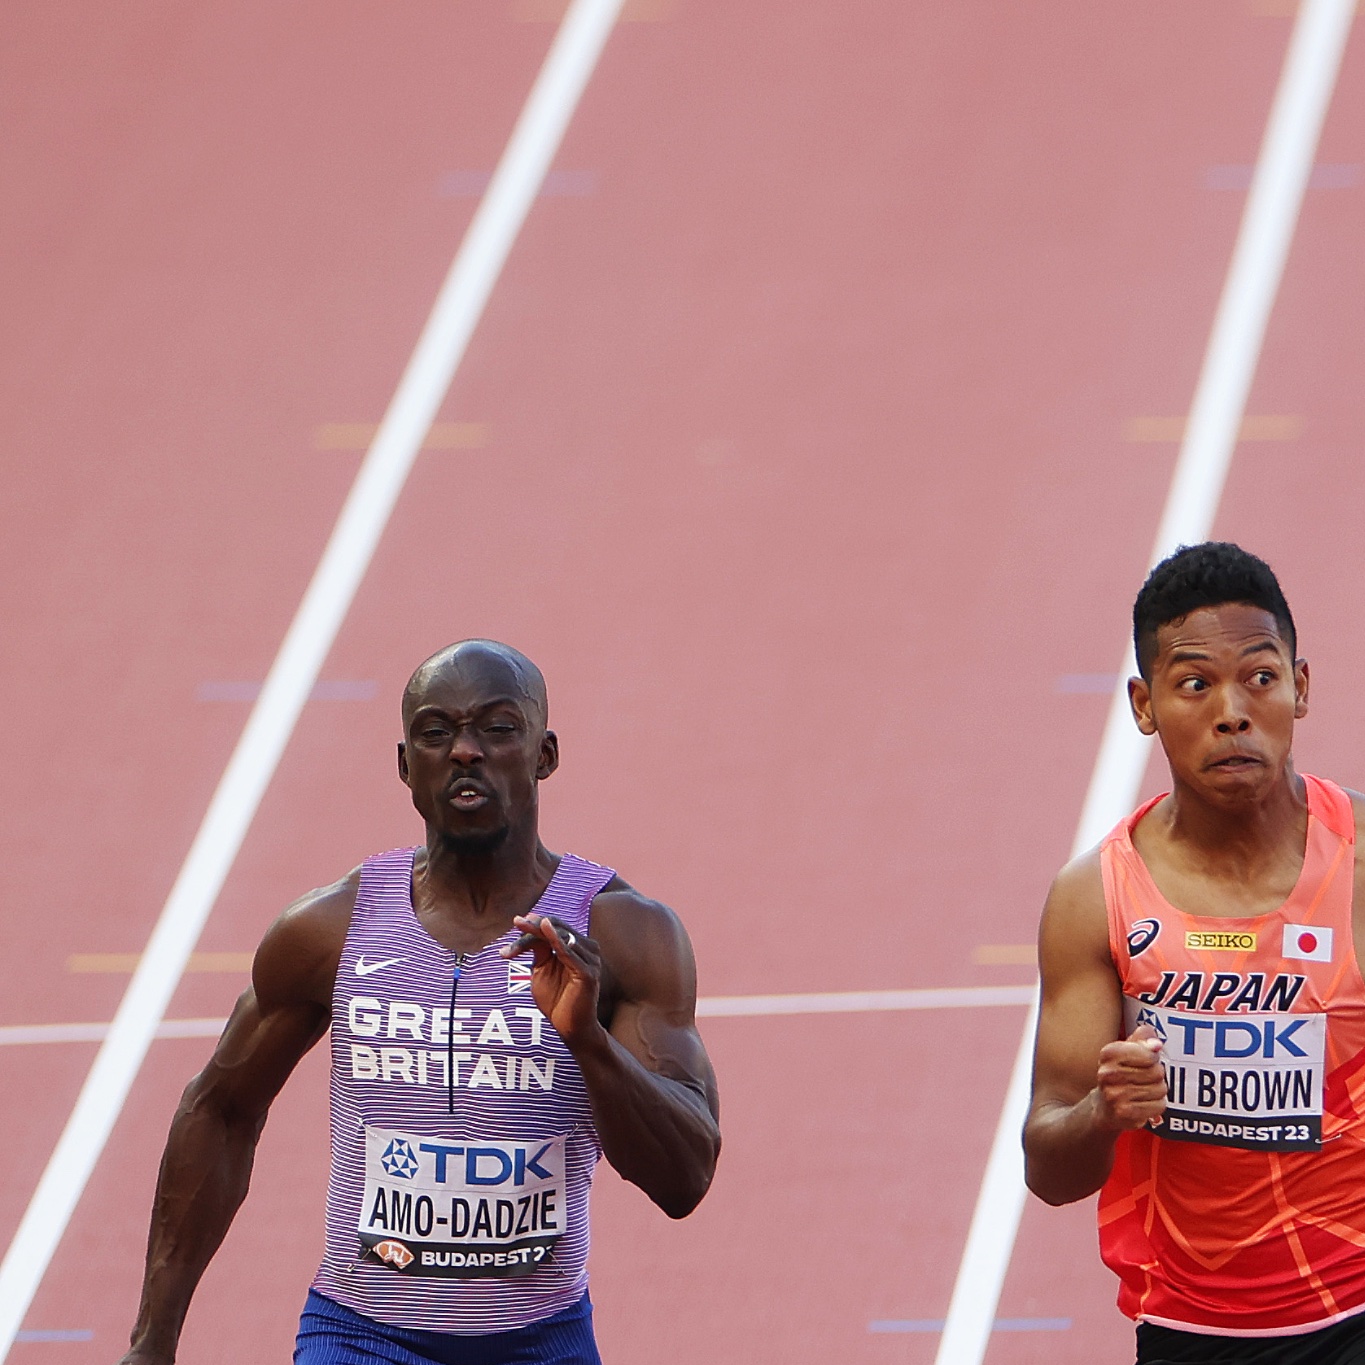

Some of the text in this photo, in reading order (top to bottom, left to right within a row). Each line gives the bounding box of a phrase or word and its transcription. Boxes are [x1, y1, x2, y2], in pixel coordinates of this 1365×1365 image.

[1187, 932, 1254, 949] SEIKO
[1138, 971, 1307, 1012] JAPAN
[347, 996, 555, 1046] GREAT
[1168, 1016, 1310, 1059] TDK
[350, 1044, 558, 1091] BRITAIN
[1161, 1061, 1313, 1112] NI BROWN
[1169, 1117, 1310, 1141] BUDAPEST 23
[419, 1141, 554, 1187] TDK
[368, 1188, 558, 1239] AMO-DADZIE
[421, 1247, 531, 1267] BUDAPEST
